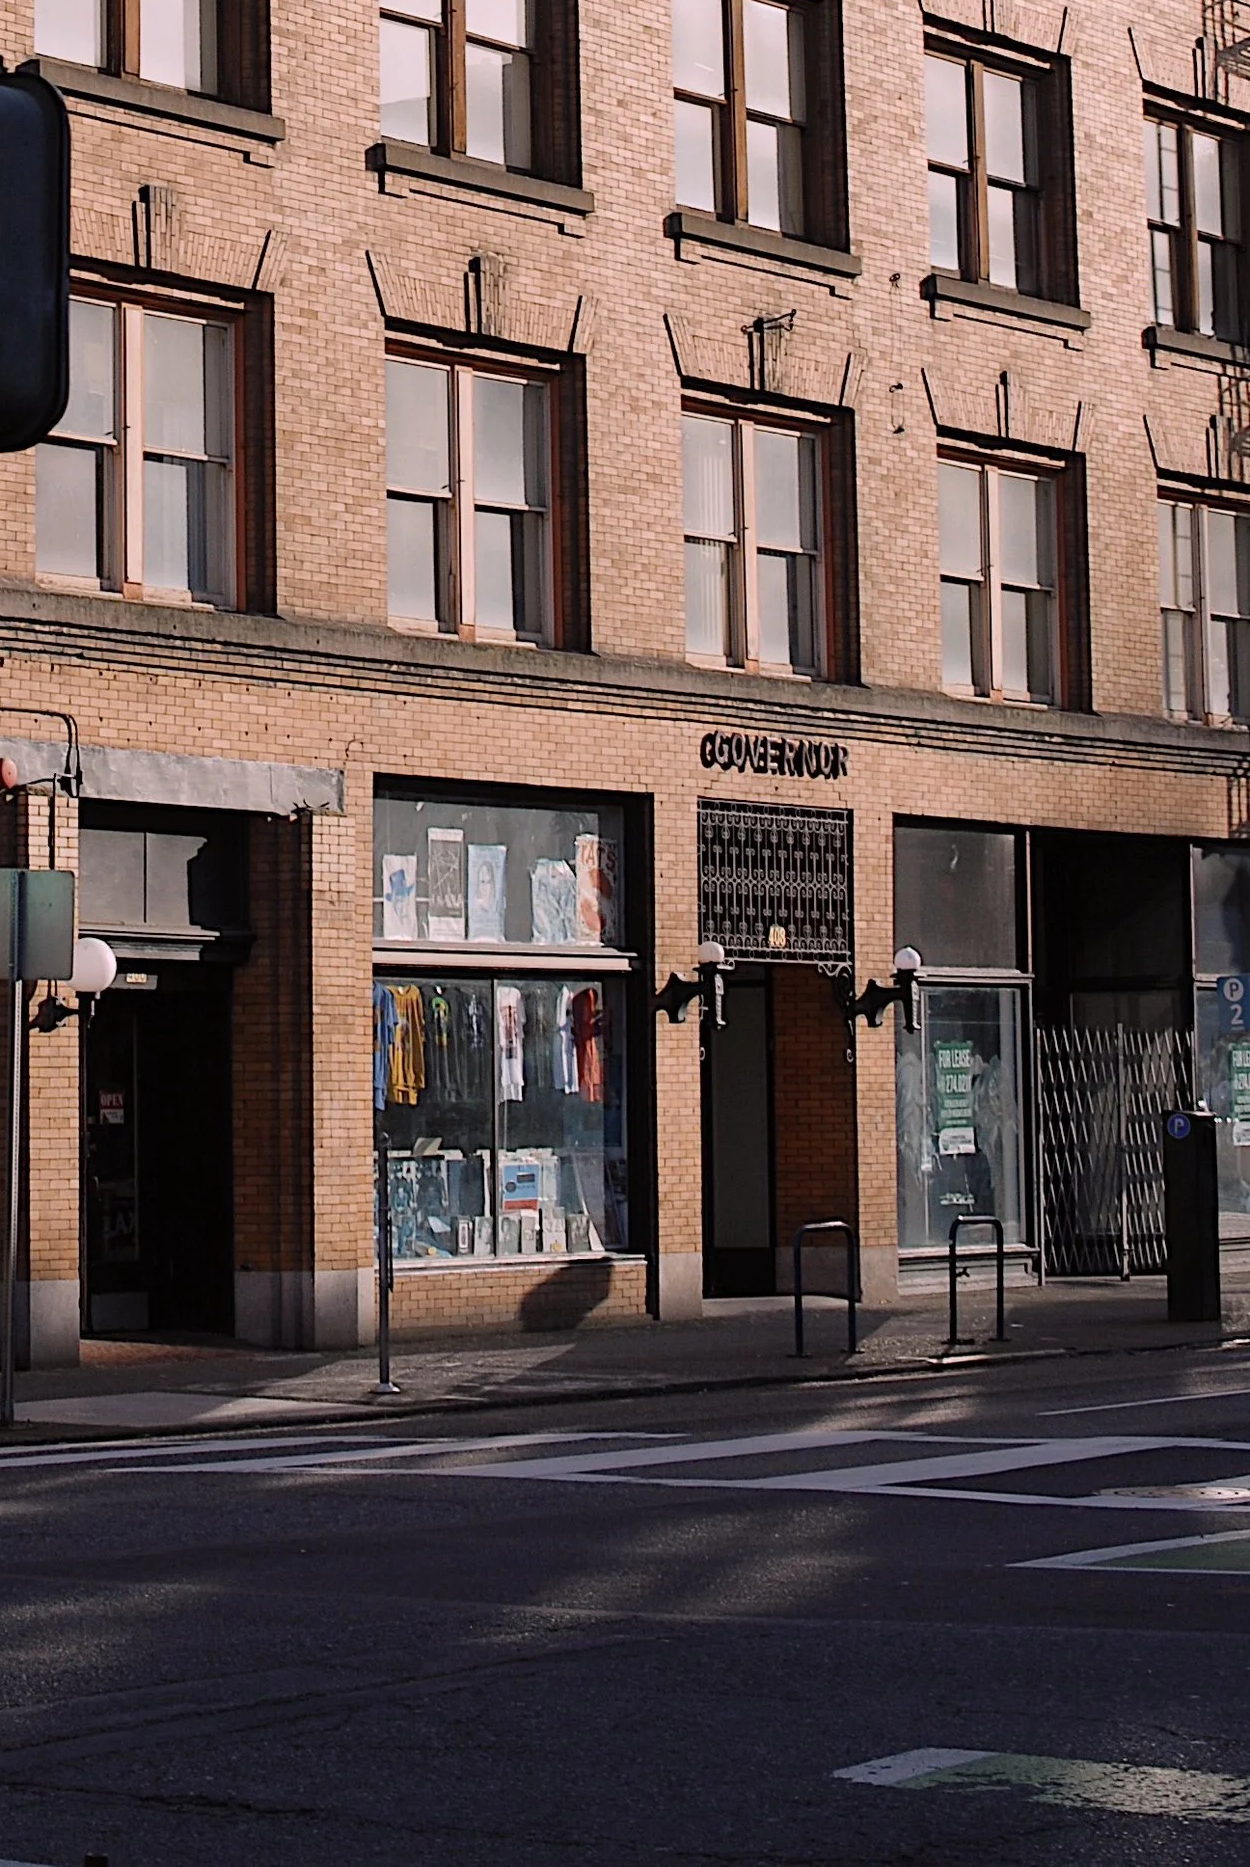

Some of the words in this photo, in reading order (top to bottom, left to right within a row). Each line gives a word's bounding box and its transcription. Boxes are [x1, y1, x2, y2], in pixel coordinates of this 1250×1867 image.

[713, 730, 849, 777] GOVERNOR
[768, 924, 787, 948] 408
[1230, 982, 1239, 998] P
[1230, 1004, 1244, 1025] 2
[938, 1049, 952, 1068] FOR
[952, 1049, 971, 1068] LEASE
[100, 1093, 124, 1107] OPEN
[1174, 1118, 1185, 1133] P
